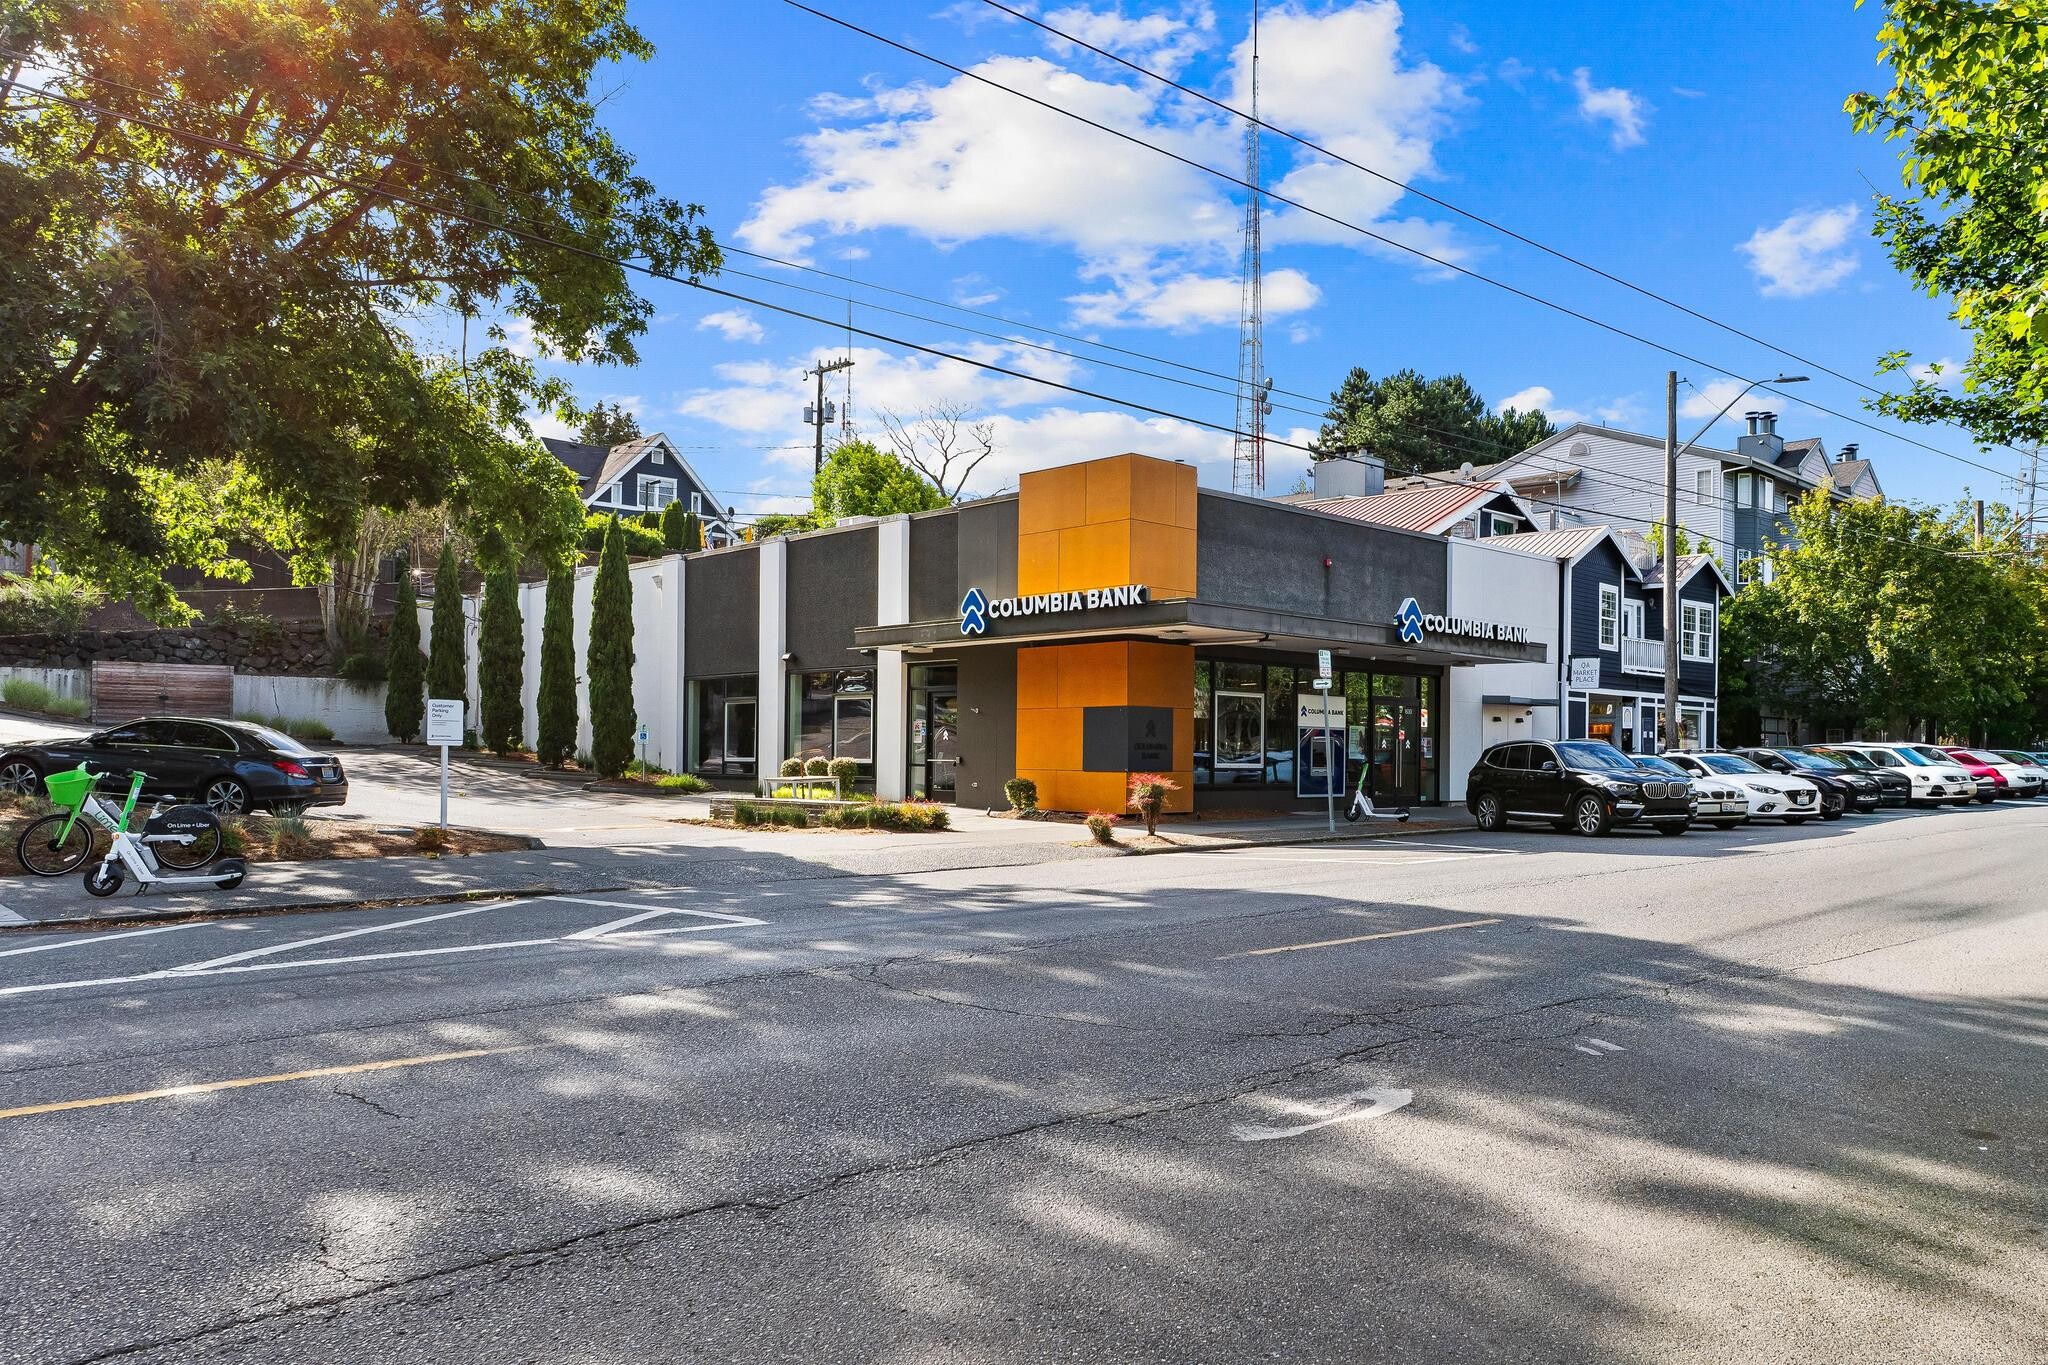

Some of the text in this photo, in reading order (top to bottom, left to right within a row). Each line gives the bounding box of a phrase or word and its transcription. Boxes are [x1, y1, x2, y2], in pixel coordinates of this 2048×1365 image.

[988, 584, 1145, 619] COLUMBIA BANK
[1425, 613, 1530, 644] COLUMBIA BANK
[94, 810, 118, 833] Lime
